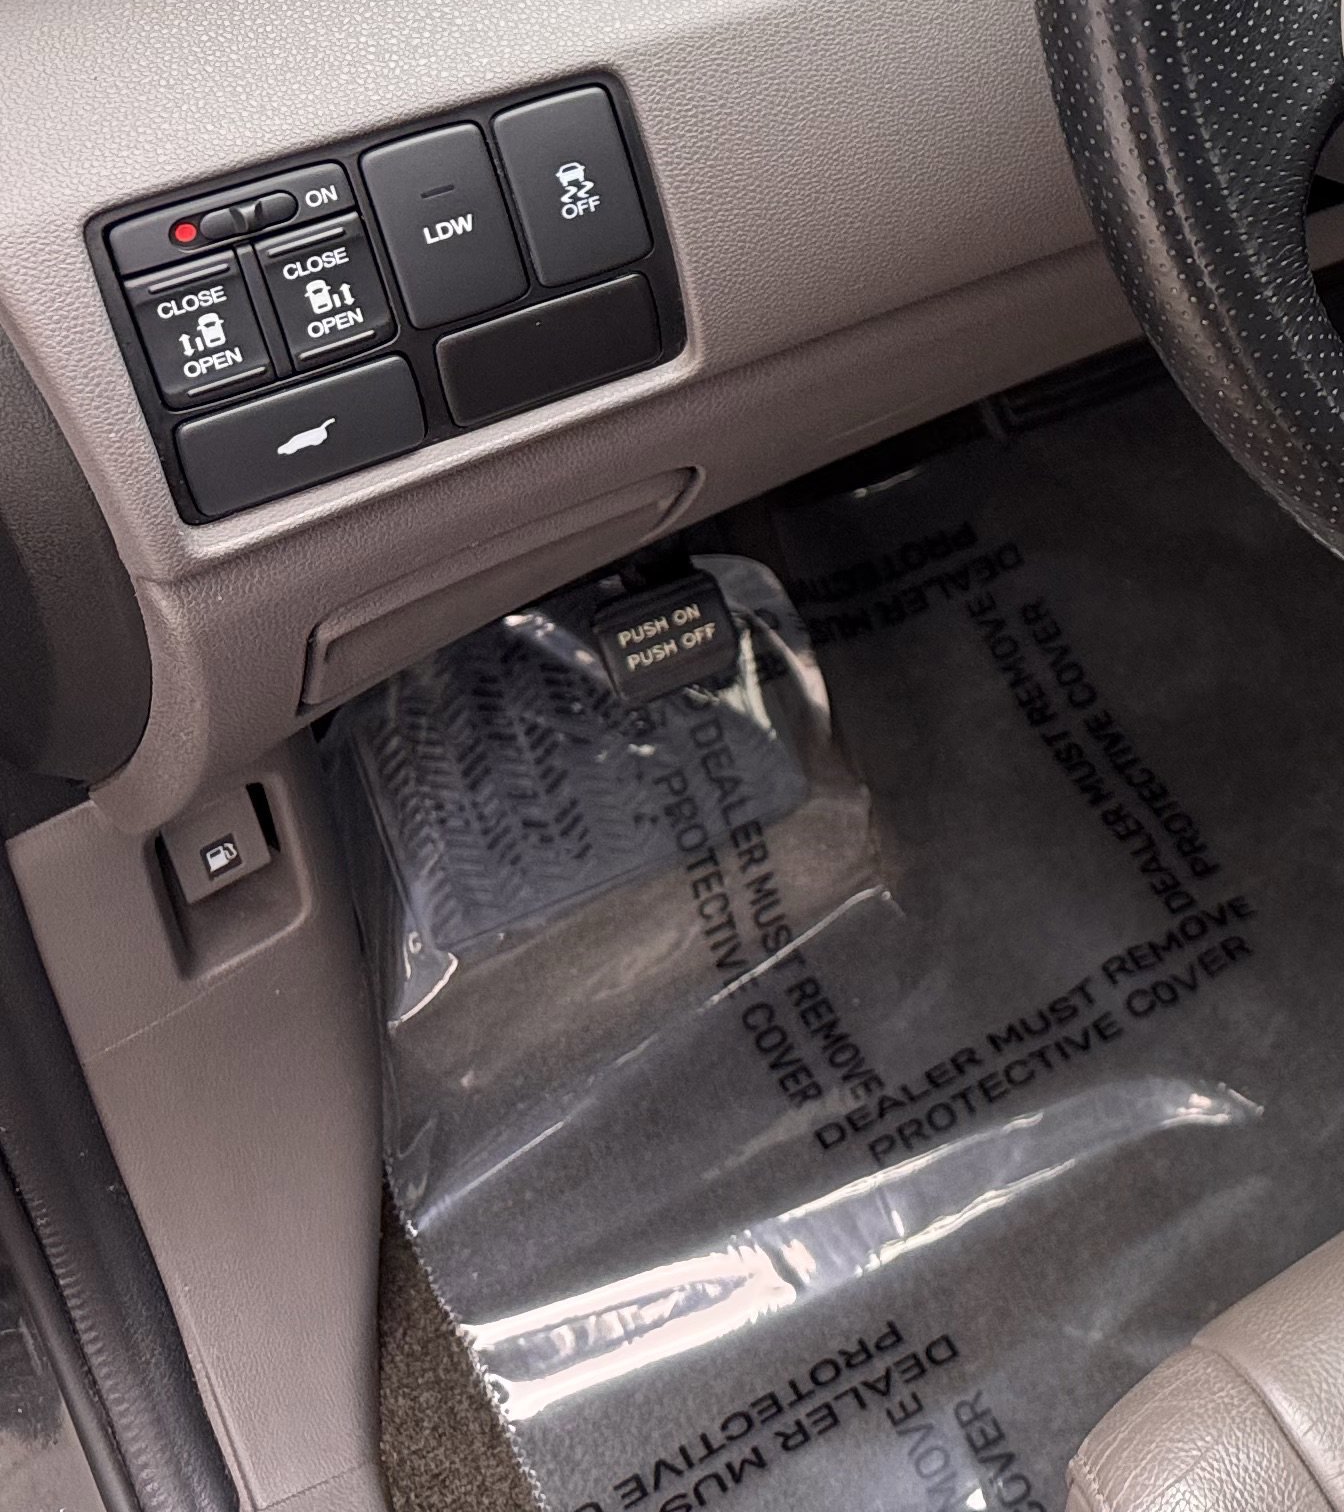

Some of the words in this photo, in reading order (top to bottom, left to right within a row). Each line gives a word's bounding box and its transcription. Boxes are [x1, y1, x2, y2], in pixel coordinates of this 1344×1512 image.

[305, 185, 339, 209] ON
[561, 195, 601, 222] OFF
[422, 213, 475, 246] LDW
[282, 247, 350, 281] CLOSE
[155, 285, 228, 321] CLOSE
[306, 307, 364, 340] OPEN
[182, 346, 244, 380] OPEN
[617, 616, 670, 649] PUSH
[671, 603, 702, 627] ON
[626, 639, 679, 672] PUSH
[679, 622, 717, 649] OFF
[1102, 804, 1197, 914] DEALER
[690, 717, 769, 874] DEALER
[785, 977, 886, 1101] REMOVE
[815, 1047, 982, 1150] DEALER
[987, 976, 1095, 1052] MUST
[1102, 895, 1257, 985] REMOVE
[741, 1002, 823, 1106] COVER
[869, 1010, 1123, 1167] PROTECTIVE
[1126, 936, 1254, 1017] COVER
[613, 1320, 905, 1510] PROTECTIVE
[775, 1333, 960, 1453] DEALER
